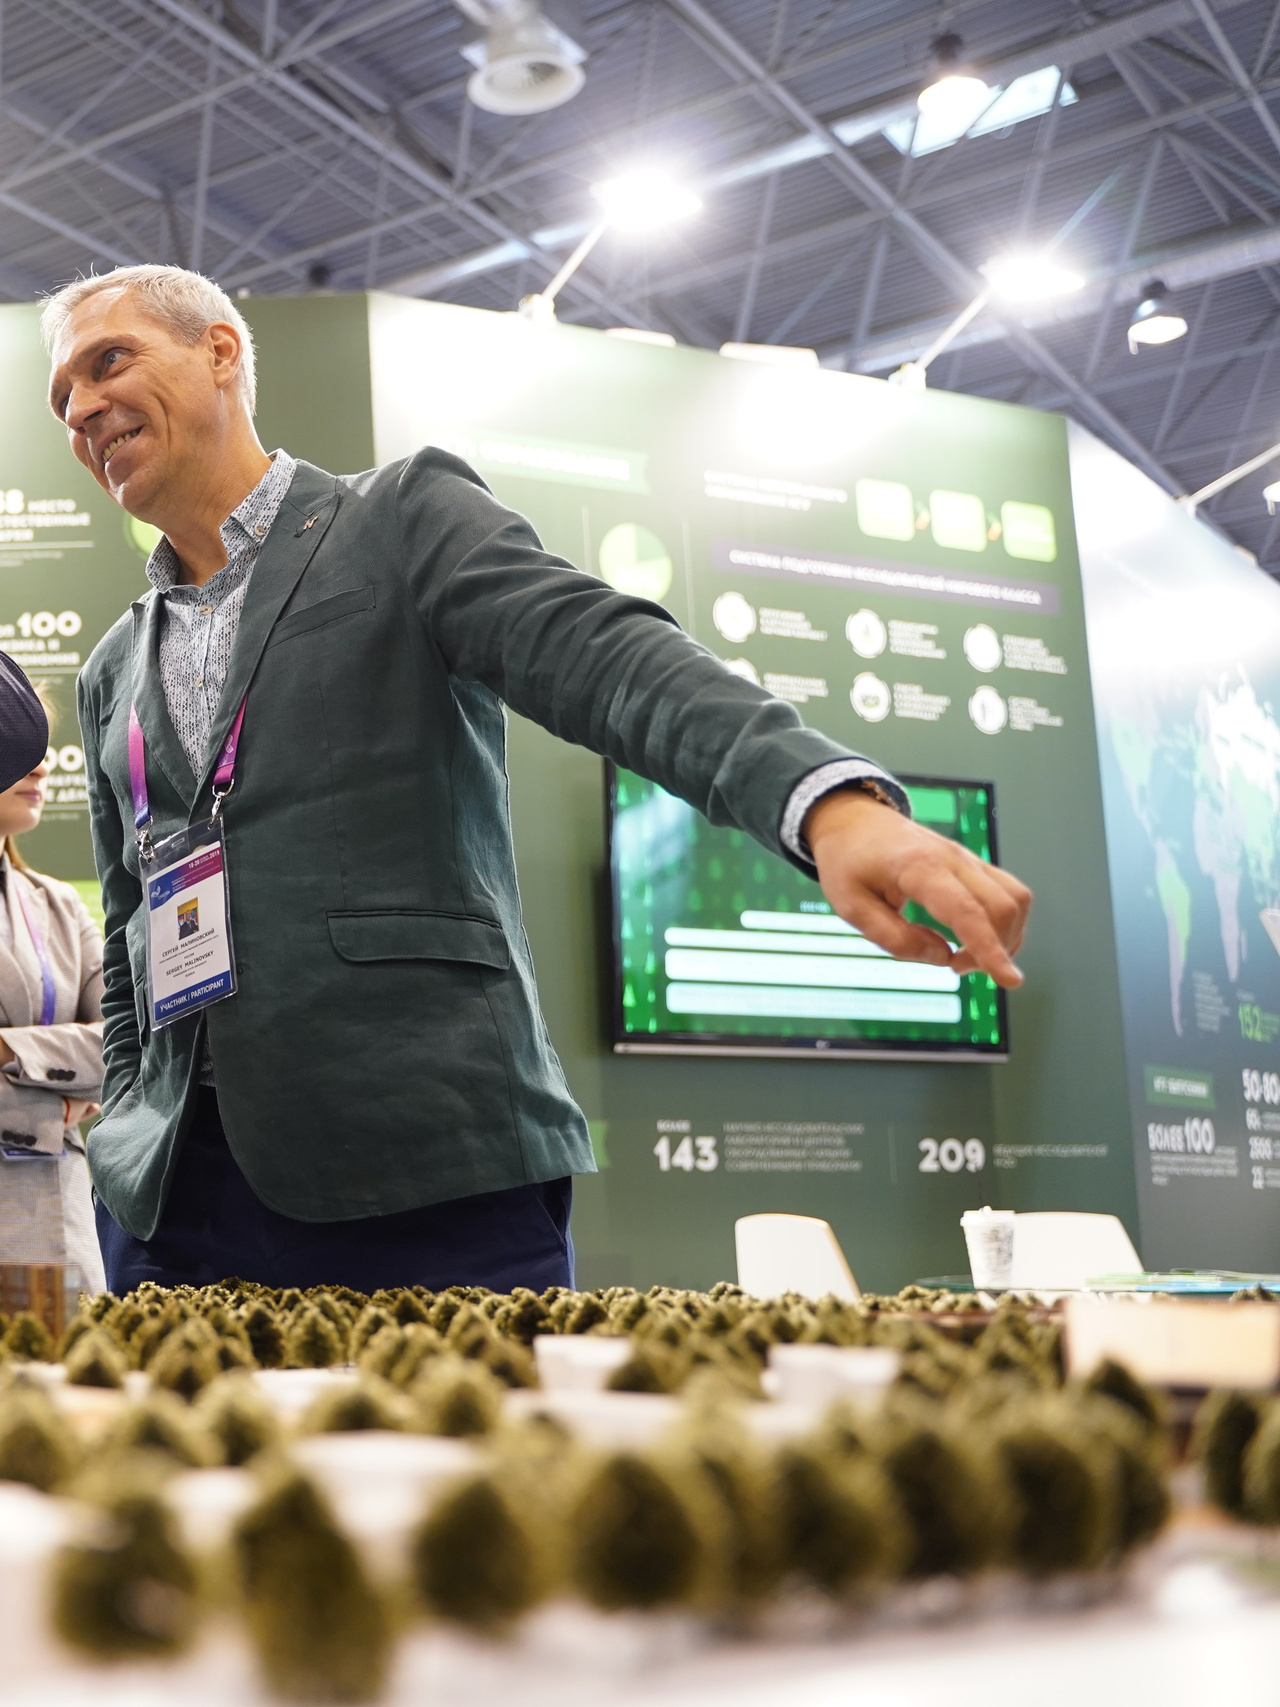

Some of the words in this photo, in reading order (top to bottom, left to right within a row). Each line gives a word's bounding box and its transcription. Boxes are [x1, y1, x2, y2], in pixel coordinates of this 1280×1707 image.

[17, 610, 82, 637] 100
[162, 945, 179, 957] СЕРГЕЙ
[180, 928, 215, 949] МАЛИНОВСКИЙ
[166, 965, 183, 976] SERGEY
[184, 950, 214, 968] MALINOVSKY
[160, 994, 188, 1012] УЧАСТНИК
[190, 979, 224, 999] PARTICIPANT
[1242, 1068, 1280, 1105] 50-80
[1148, 1122, 1186, 1152] БОЛЕЕ
[1185, 1116, 1215, 1154] 100
[653, 1135, 719, 1172] 143
[918, 1138, 986, 1173] 209
